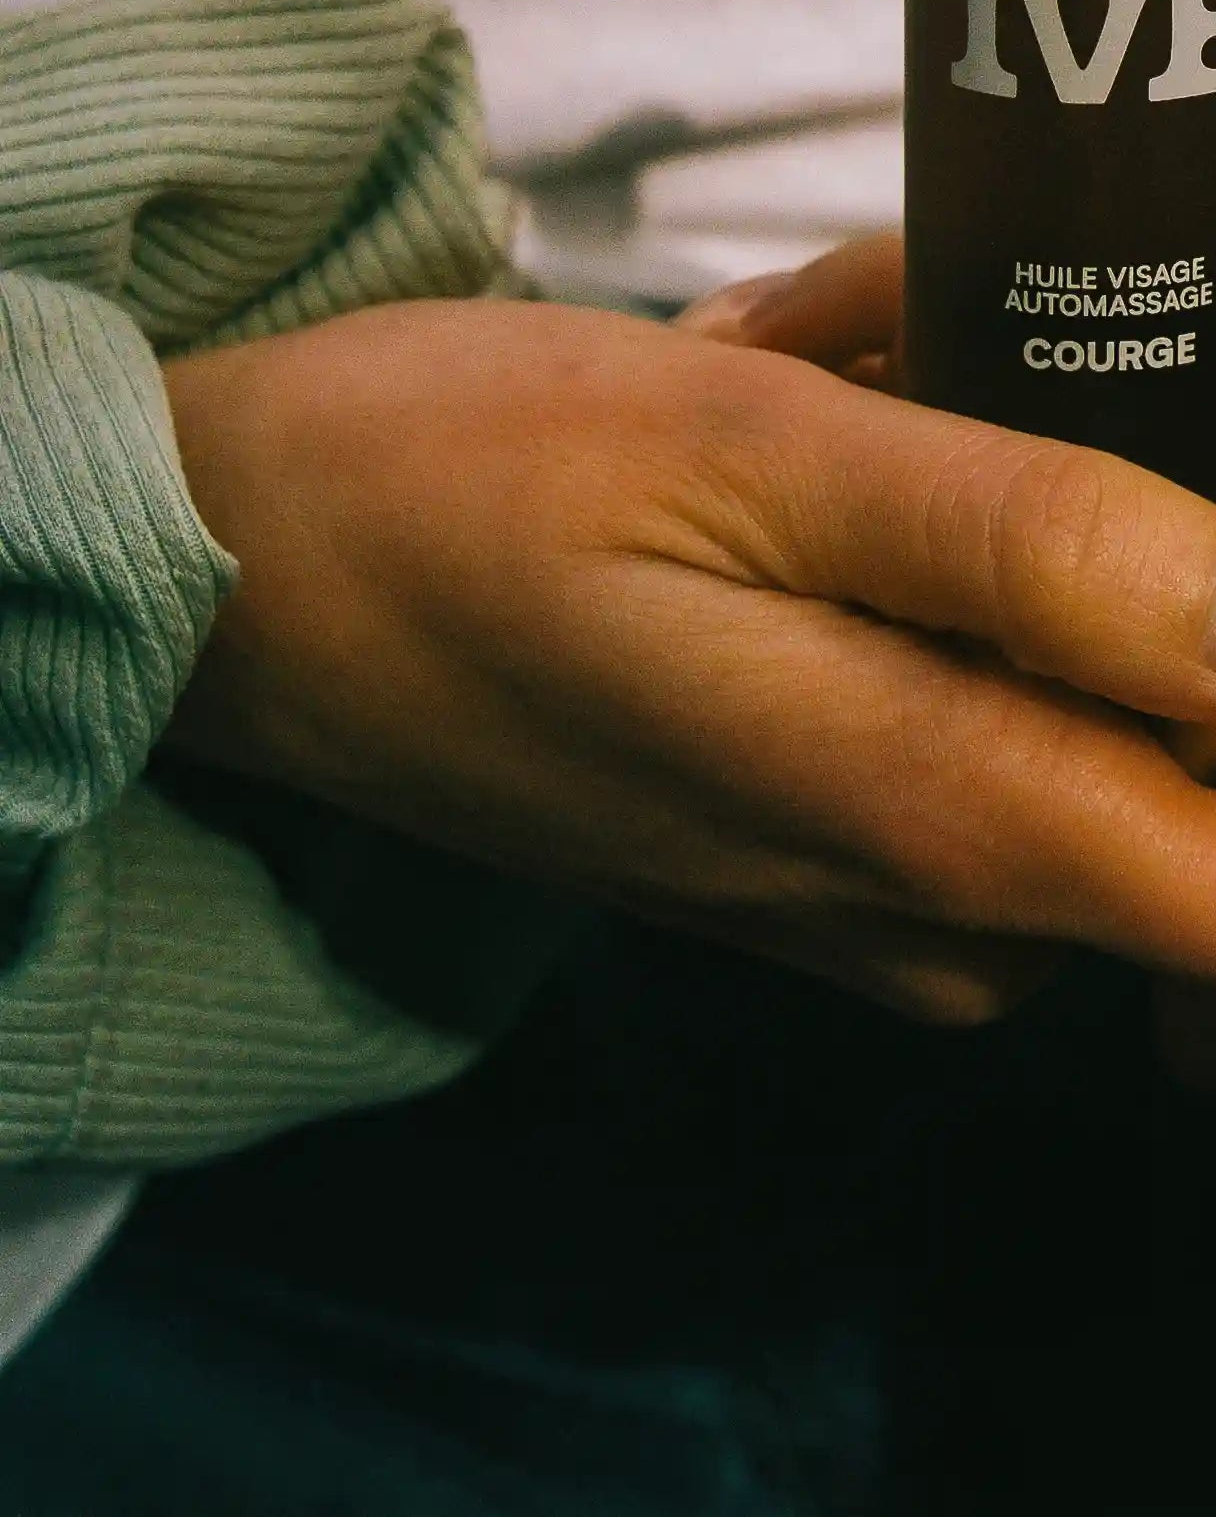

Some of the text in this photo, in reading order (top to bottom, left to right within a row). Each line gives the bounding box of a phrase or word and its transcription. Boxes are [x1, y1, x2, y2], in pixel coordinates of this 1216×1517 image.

[1015, 256, 1206, 290] HUILE VISAGE
[1004, 282, 1213, 317] AUTOMASSAGE
[1022, 332, 1197, 372] COURGE
